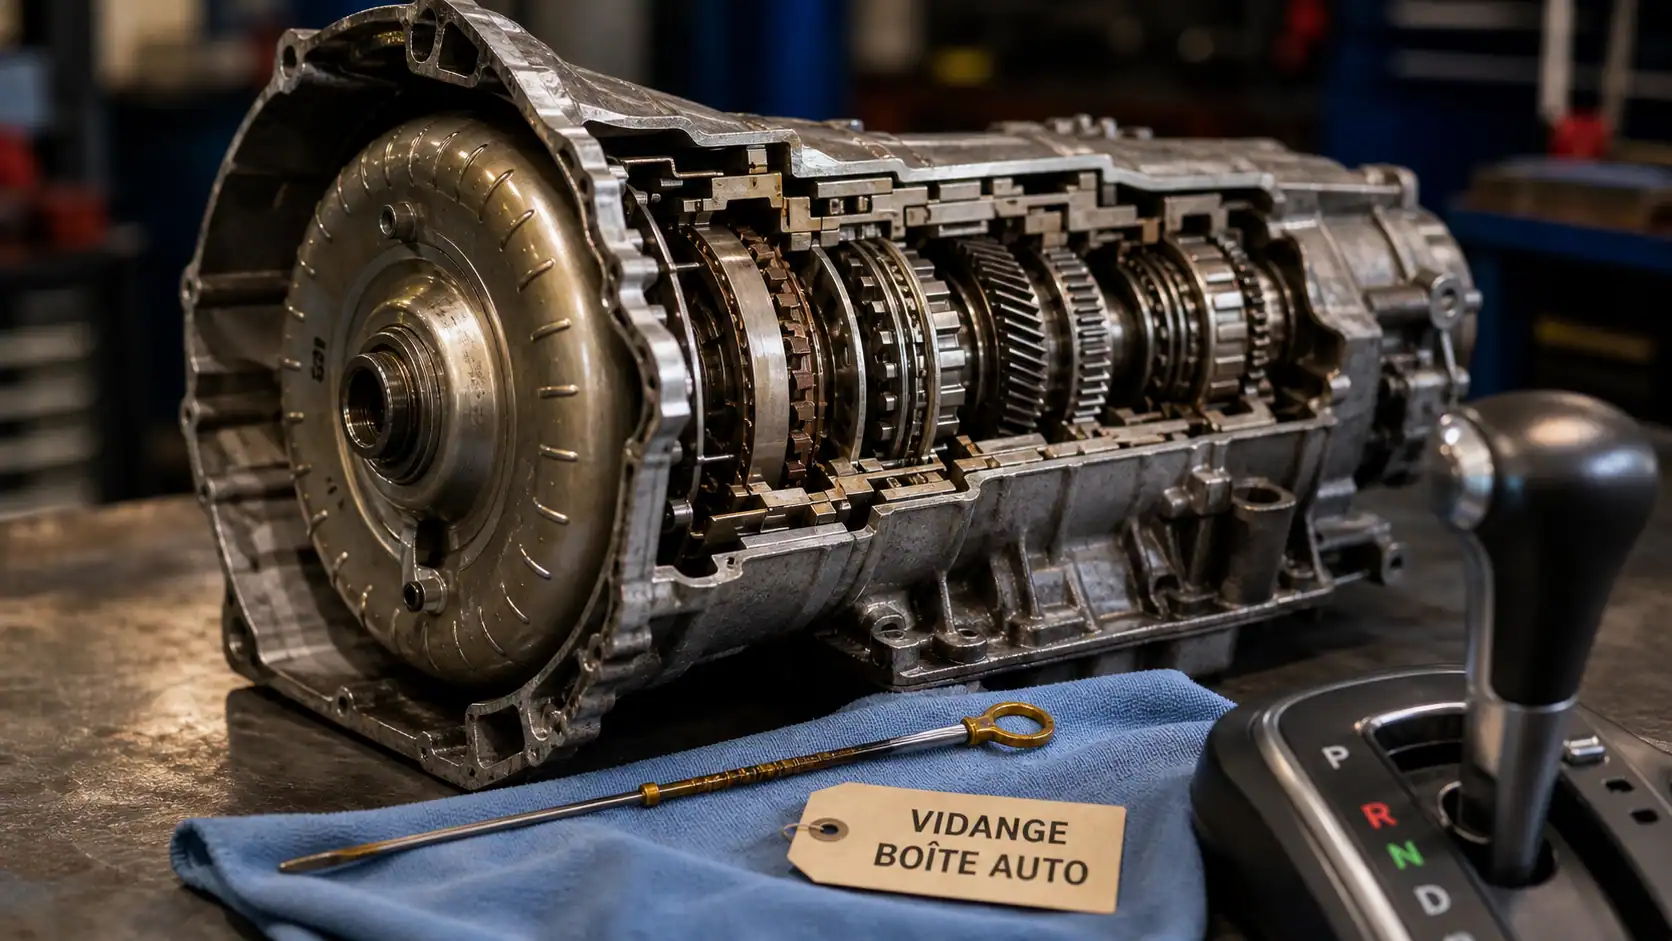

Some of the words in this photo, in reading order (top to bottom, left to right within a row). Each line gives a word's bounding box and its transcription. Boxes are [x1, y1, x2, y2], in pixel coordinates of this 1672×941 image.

[1322, 745, 1349, 770] P
[911, 809, 1069, 845] VIDANGE
[1360, 802, 1397, 830] R
[874, 841, 980, 876] BOÎTE
[989, 854, 1089, 886] AUTO
[1386, 840, 1424, 870] N
[1413, 884, 1451, 916] D
